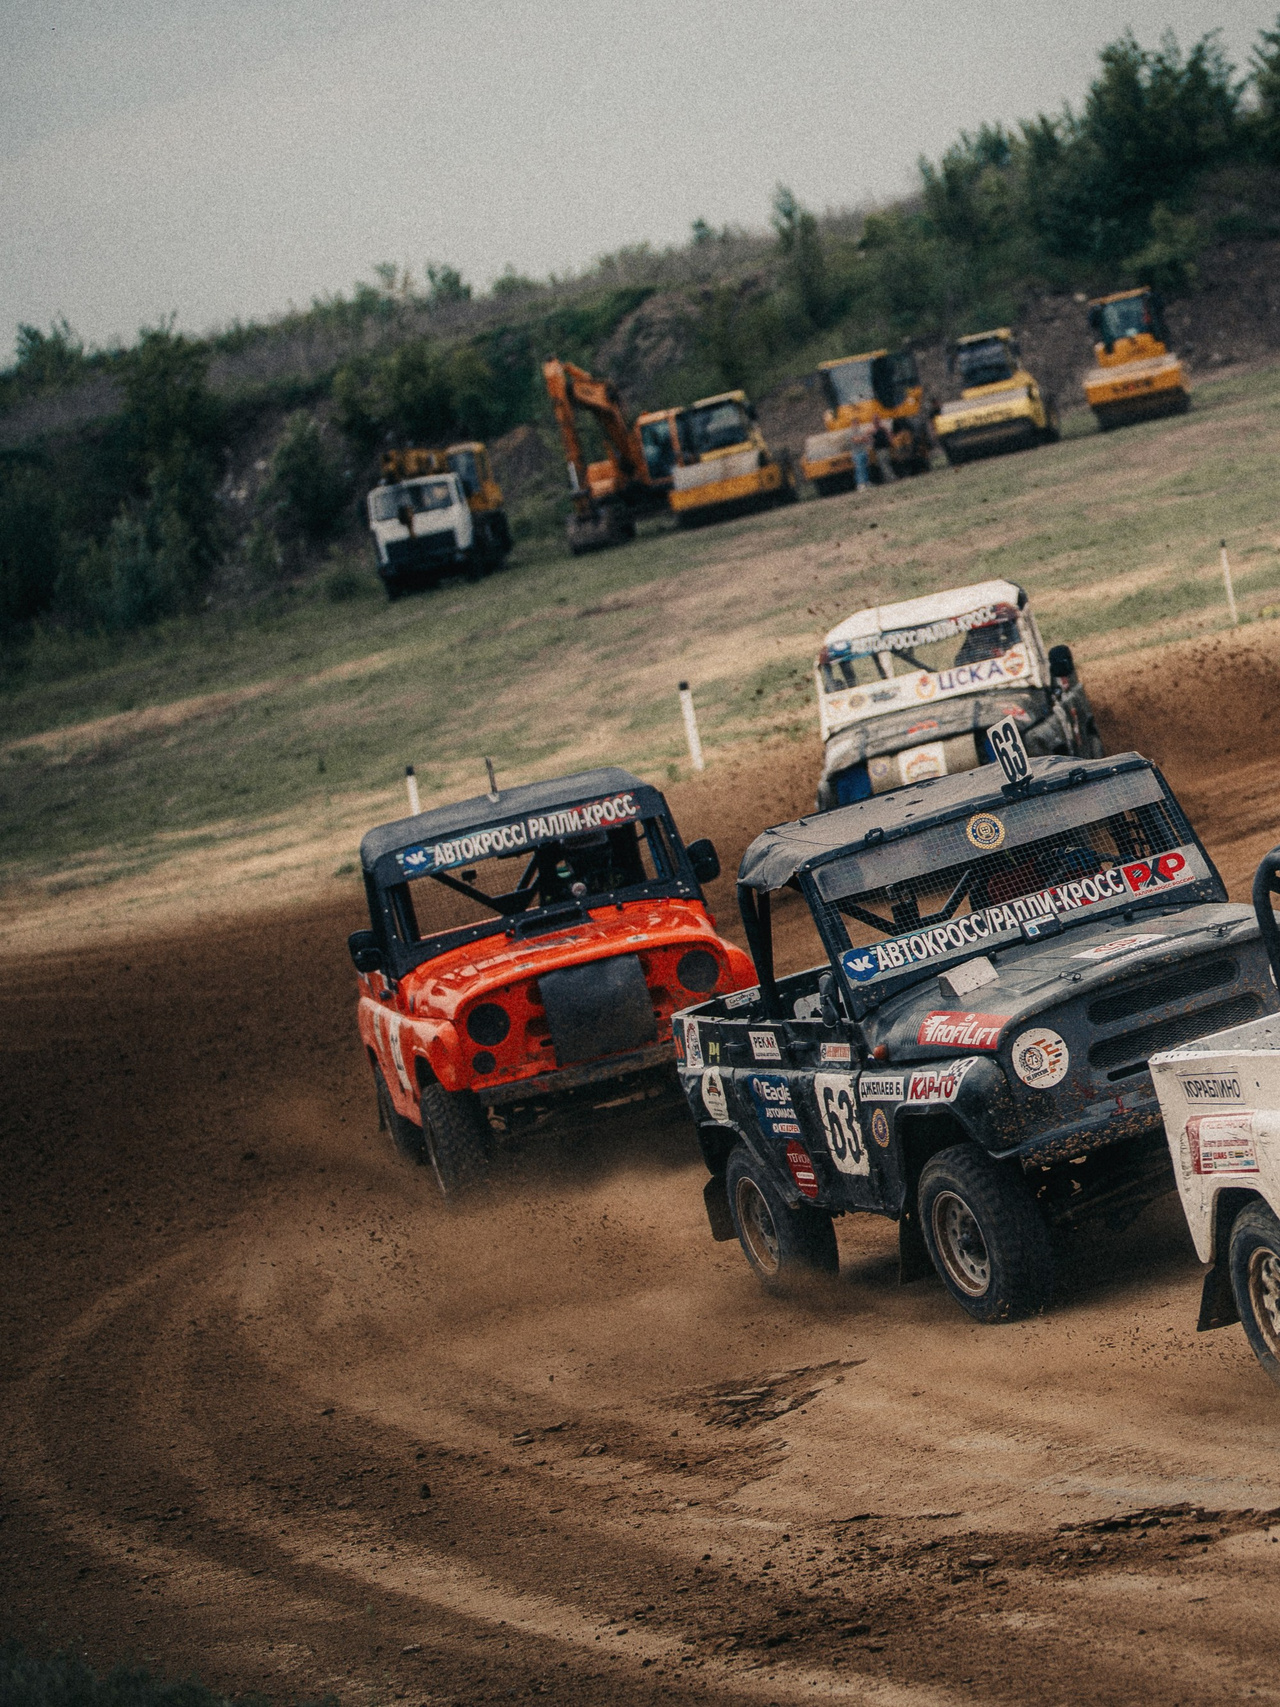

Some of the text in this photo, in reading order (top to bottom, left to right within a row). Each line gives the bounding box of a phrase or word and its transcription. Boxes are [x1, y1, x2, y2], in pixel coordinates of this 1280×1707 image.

[938, 660, 1003, 690] ЦСКА
[992, 722, 1027, 783] 63
[528, 794, 637, 839] РАЛЛИ-КРОСС
[753, 1037, 776, 1049] PEKAR
[763, 1082, 792, 1105] Eagle
[1182, 1078, 1241, 1099] КОРАБЛИНО
[823, 1087, 861, 1164] 63
